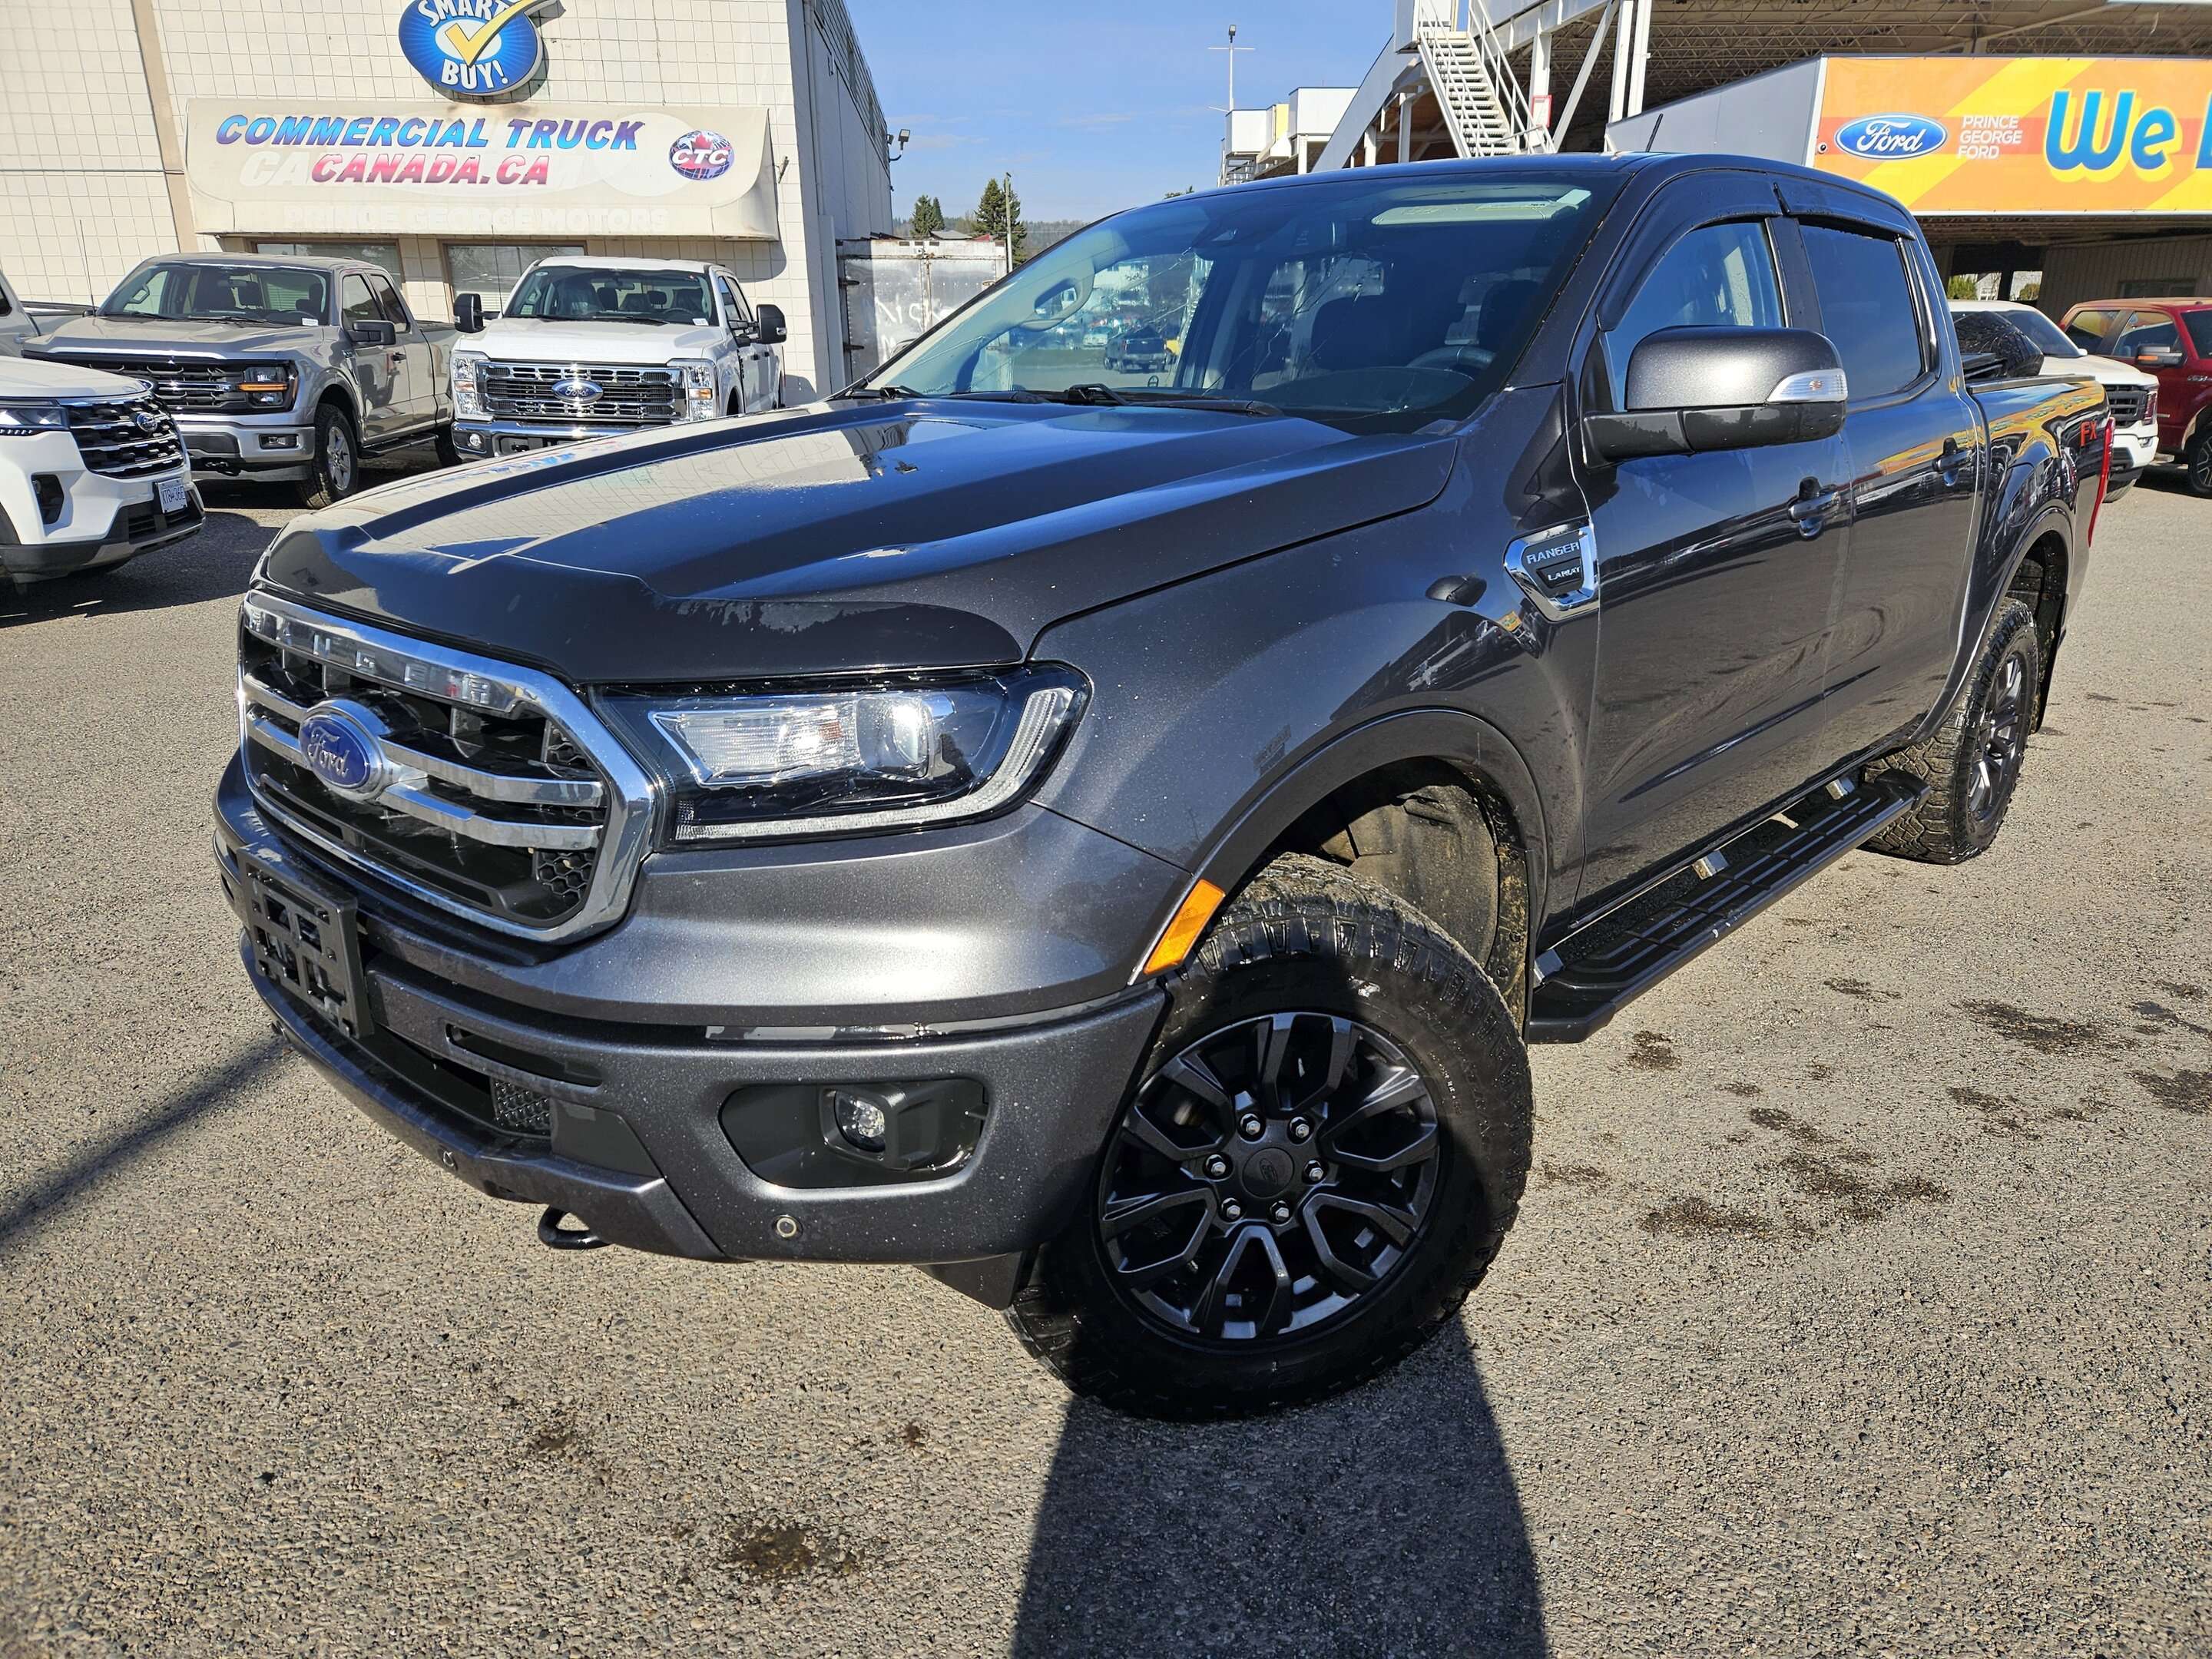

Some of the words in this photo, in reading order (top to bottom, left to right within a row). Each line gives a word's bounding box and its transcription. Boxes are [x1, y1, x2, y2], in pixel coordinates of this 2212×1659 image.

[440, 58, 508, 90] BUY!
[216, 114, 489, 147] COMMERCIAL
[506, 118, 645, 151] TRUCK
[1857, 120, 1923, 153] Ford
[1959, 129, 2022, 145] GEORGE
[1962, 115, 2020, 130] PRINCE
[2045, 90, 2176, 171] We
[671, 148, 730, 166] CTC
[1956, 144, 2001, 160] FORD
[311, 154, 551, 184] CANADA.CA
[1525, 541, 1580, 565] RANGER
[307, 726, 351, 778] Ford
